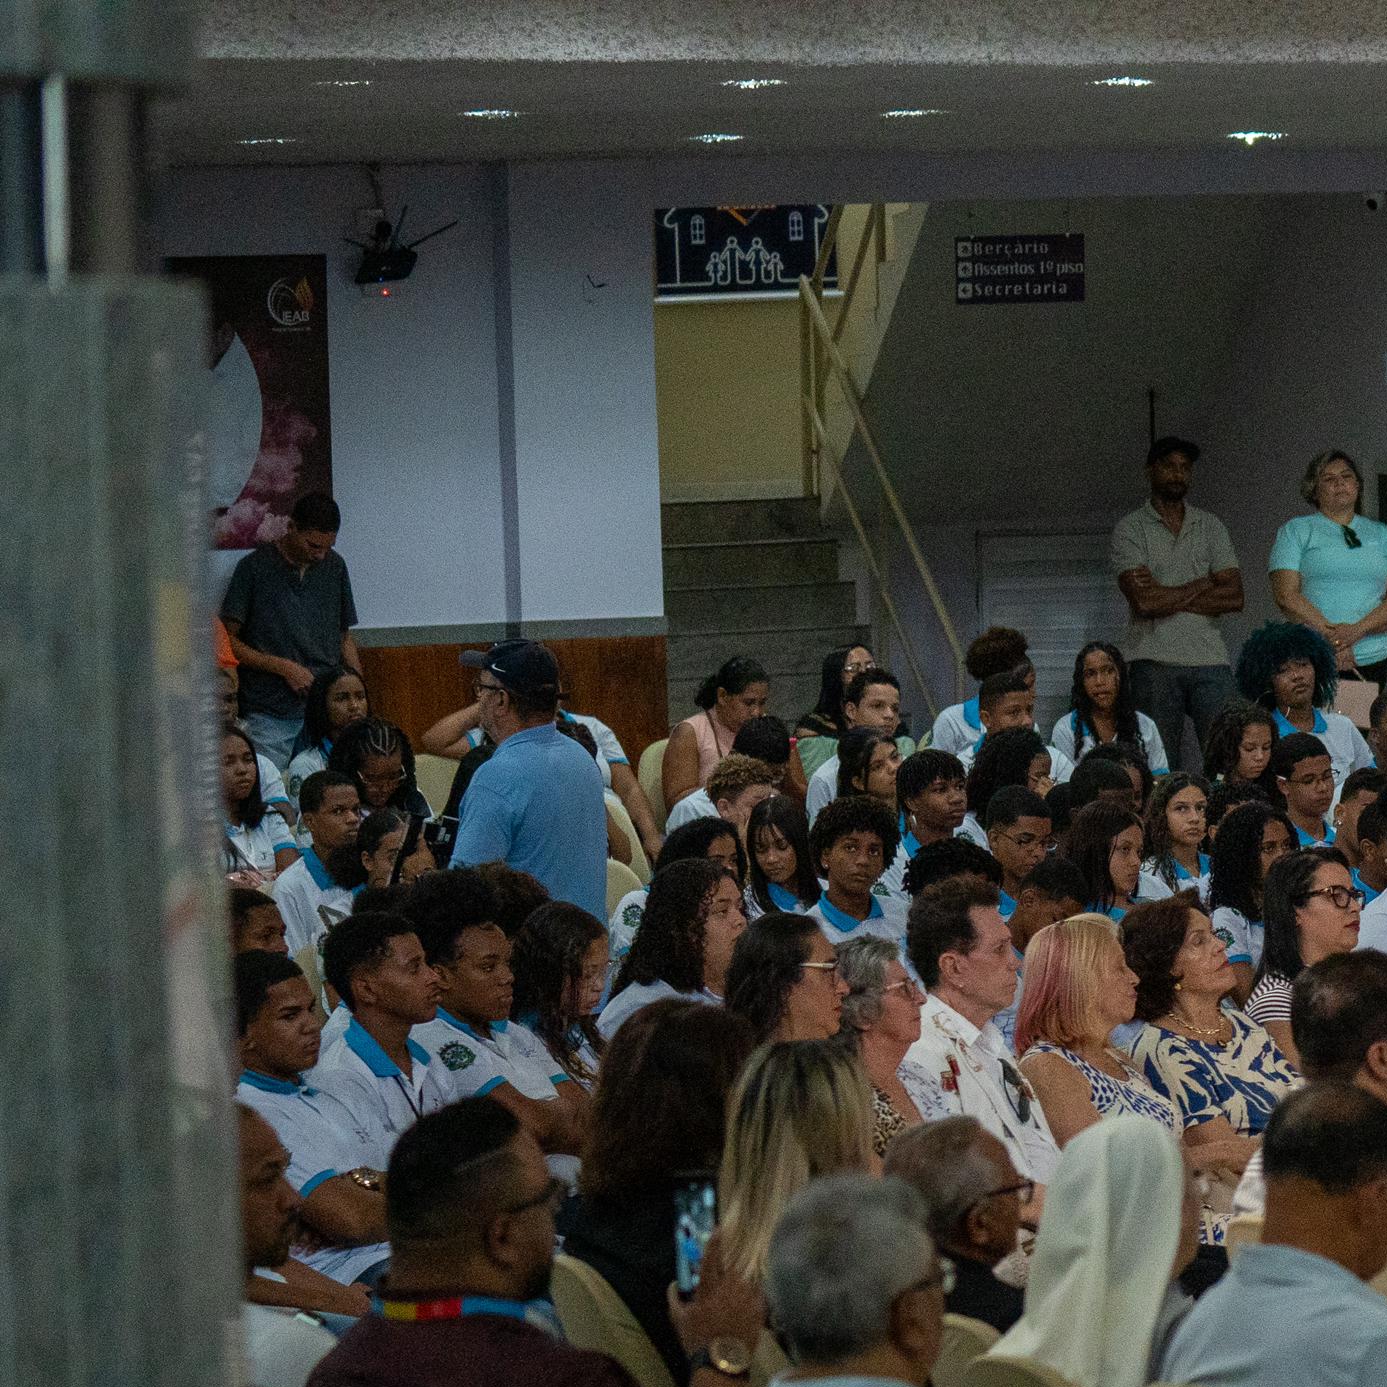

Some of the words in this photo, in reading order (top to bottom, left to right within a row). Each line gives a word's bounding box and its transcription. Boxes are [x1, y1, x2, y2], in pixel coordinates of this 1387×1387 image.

[974, 261, 1035, 276] Assentos
[1056, 261, 1084, 276] piso
[974, 282, 1068, 296] Secretaria
